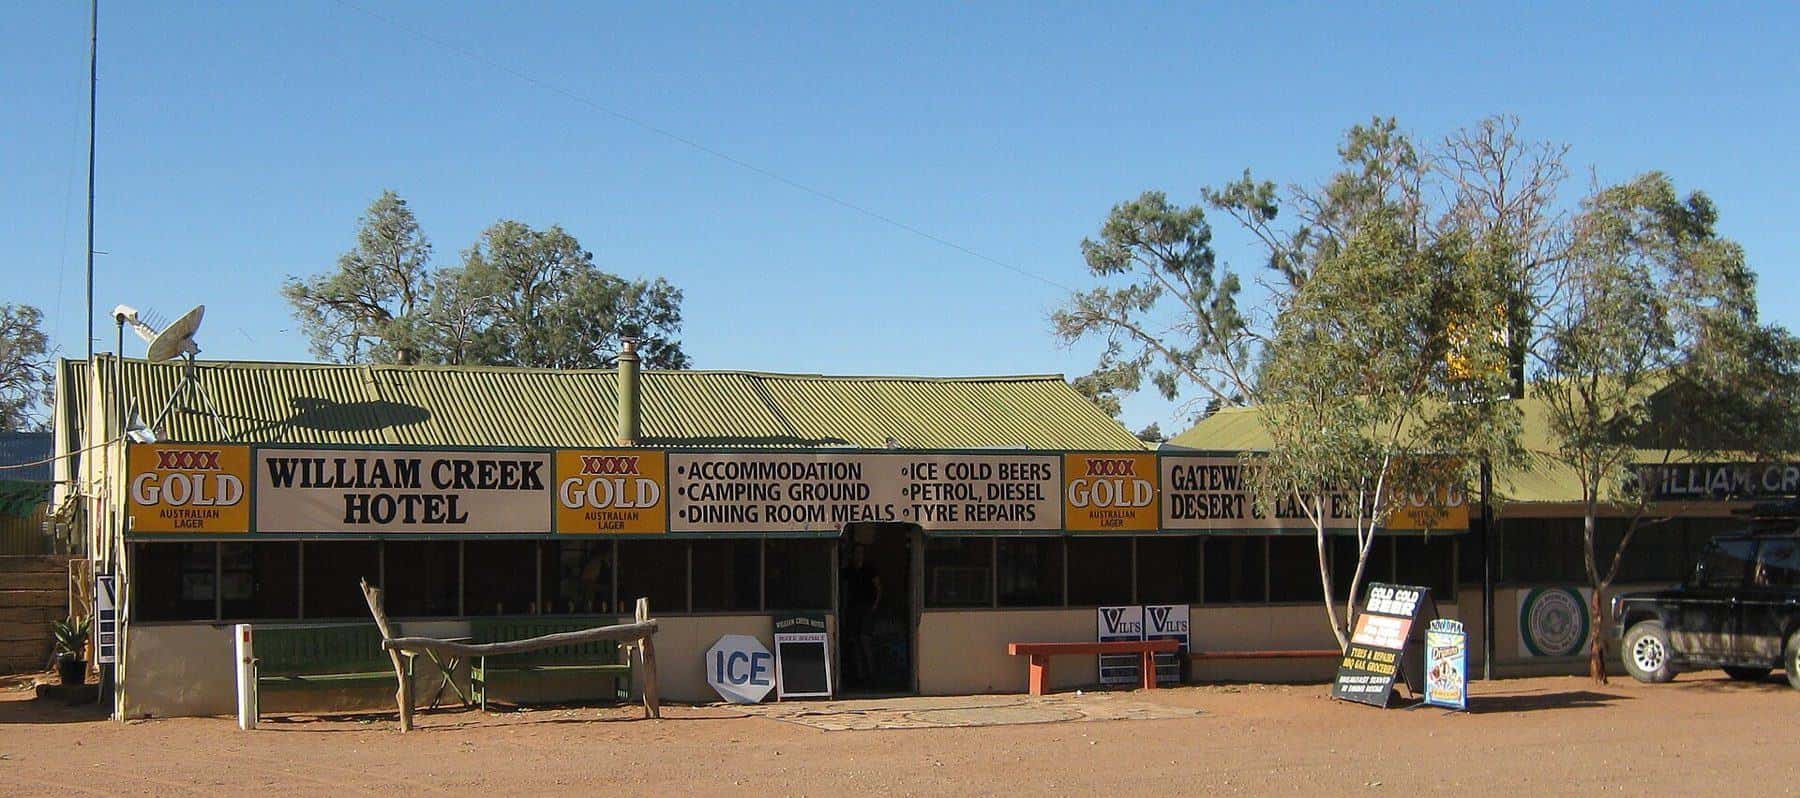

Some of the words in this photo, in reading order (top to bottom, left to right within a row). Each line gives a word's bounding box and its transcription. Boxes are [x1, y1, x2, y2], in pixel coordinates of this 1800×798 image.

[156, 450, 221, 470] XXXX
[580, 456, 639, 475] XXXX
[1085, 458, 1136, 476] XXXX
[266, 457, 422, 489] WILLIAM
[431, 457, 545, 491] CREEK
[688, 461, 862, 481] ACCOMMODATION
[910, 462, 937, 481] ICE
[945, 462, 991, 481] COLD
[998, 462, 1052, 481] BEERS
[1171, 465, 1262, 491] GATEW
[131, 472, 245, 507] GOLD
[559, 477, 659, 509] GOLD
[686, 482, 781, 502] CAMPING
[788, 482, 870, 502] GROUND
[910, 483, 984, 503] PETROL,
[987, 483, 1045, 501] DIESEL
[1067, 478, 1154, 508] GOLD
[1389, 482, 1465, 508] OLD
[159, 509, 220, 520] AUSTRALIAN
[343, 493, 469, 524] HOTEL
[585, 511, 640, 521] AUSTRALIAN
[688, 504, 759, 523] DINING
[765, 504, 826, 523] ROOM
[831, 503, 895, 522] MEALS
[912, 504, 959, 522] TYRE
[964, 504, 1036, 522] REPAIRS
[1088, 510, 1136, 519] AUSTRALIAN
[1170, 494, 1246, 519] DESERT
[1275, 494, 1326, 519] LAK
[174, 519, 204, 529] LAGER
[597, 521, 626, 531] LAGER
[1100, 519, 1124, 528] LAGER
[1371, 587, 1394, 601] COLD
[1395, 589, 1419, 604] COLD
[716, 650, 771, 686] ICE
